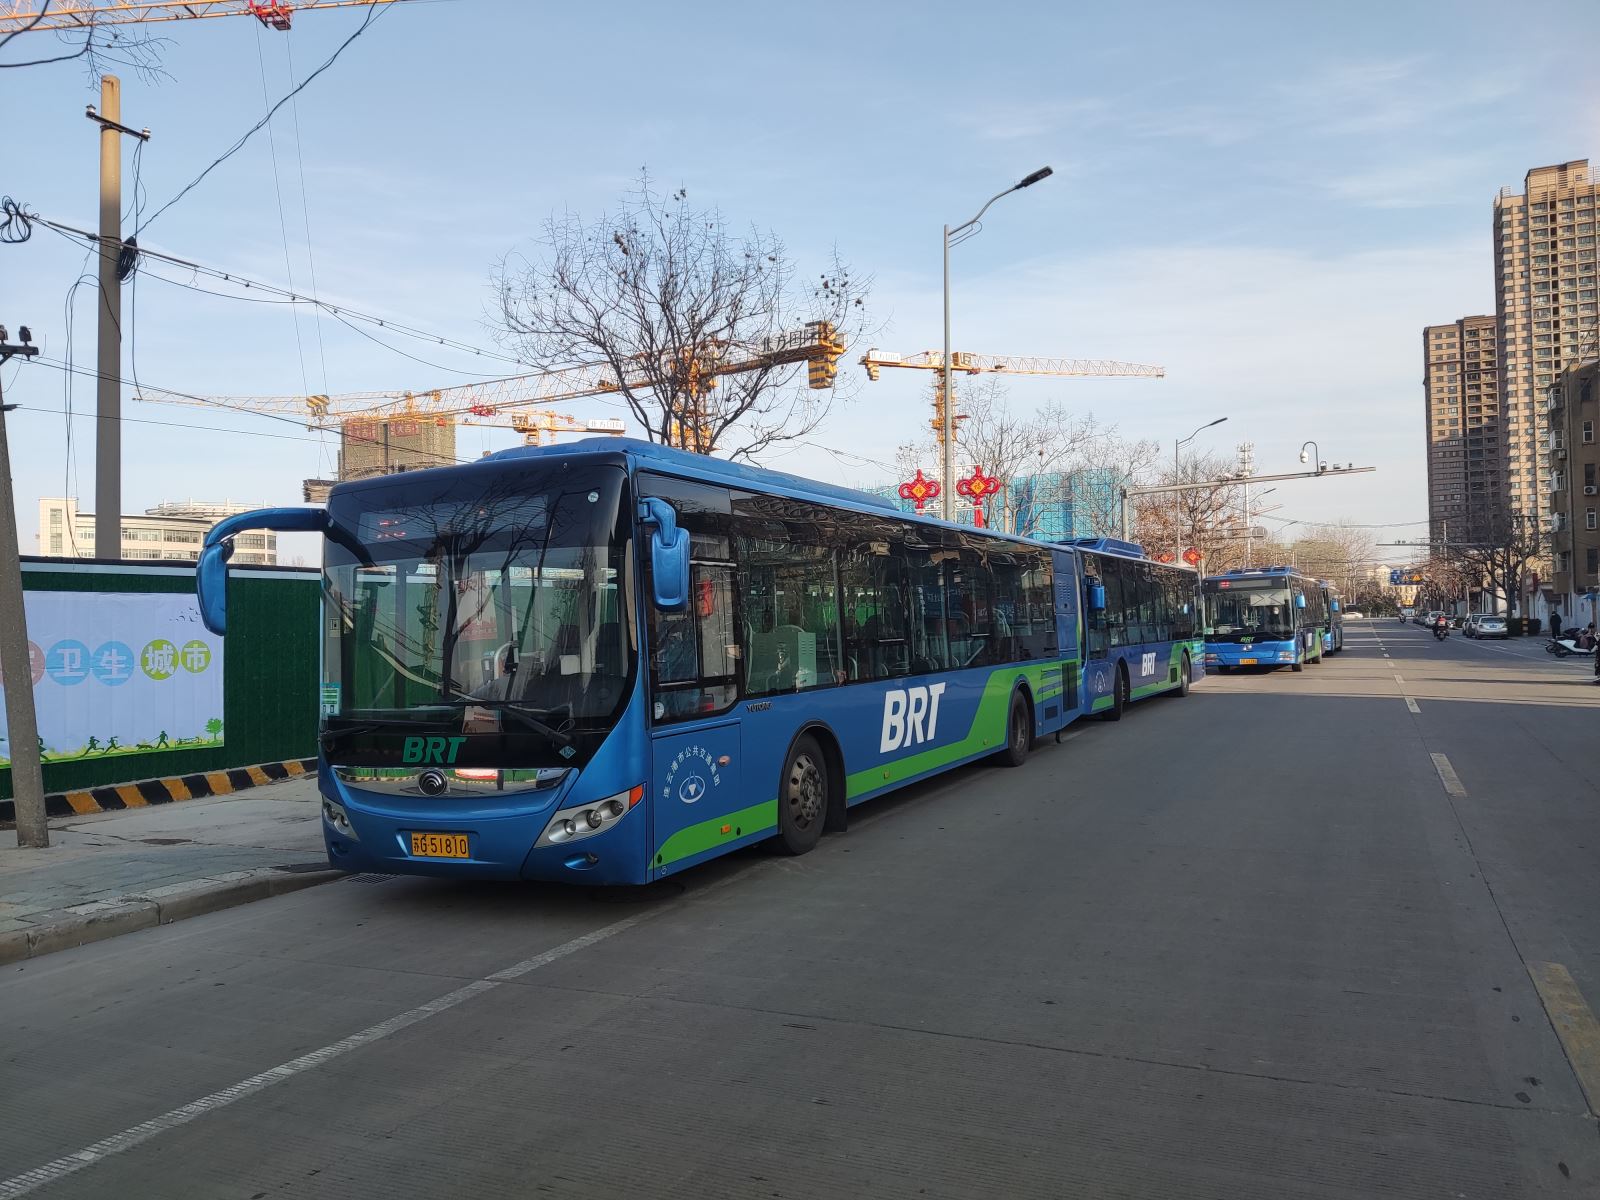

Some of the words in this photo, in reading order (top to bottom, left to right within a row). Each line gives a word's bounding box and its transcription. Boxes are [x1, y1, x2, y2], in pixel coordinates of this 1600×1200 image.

[29, 644, 210, 681] 卫生城市
[1142, 652, 1157, 677] BRT
[880, 682, 946, 754] BRT
[403, 736, 467, 763] BRT
